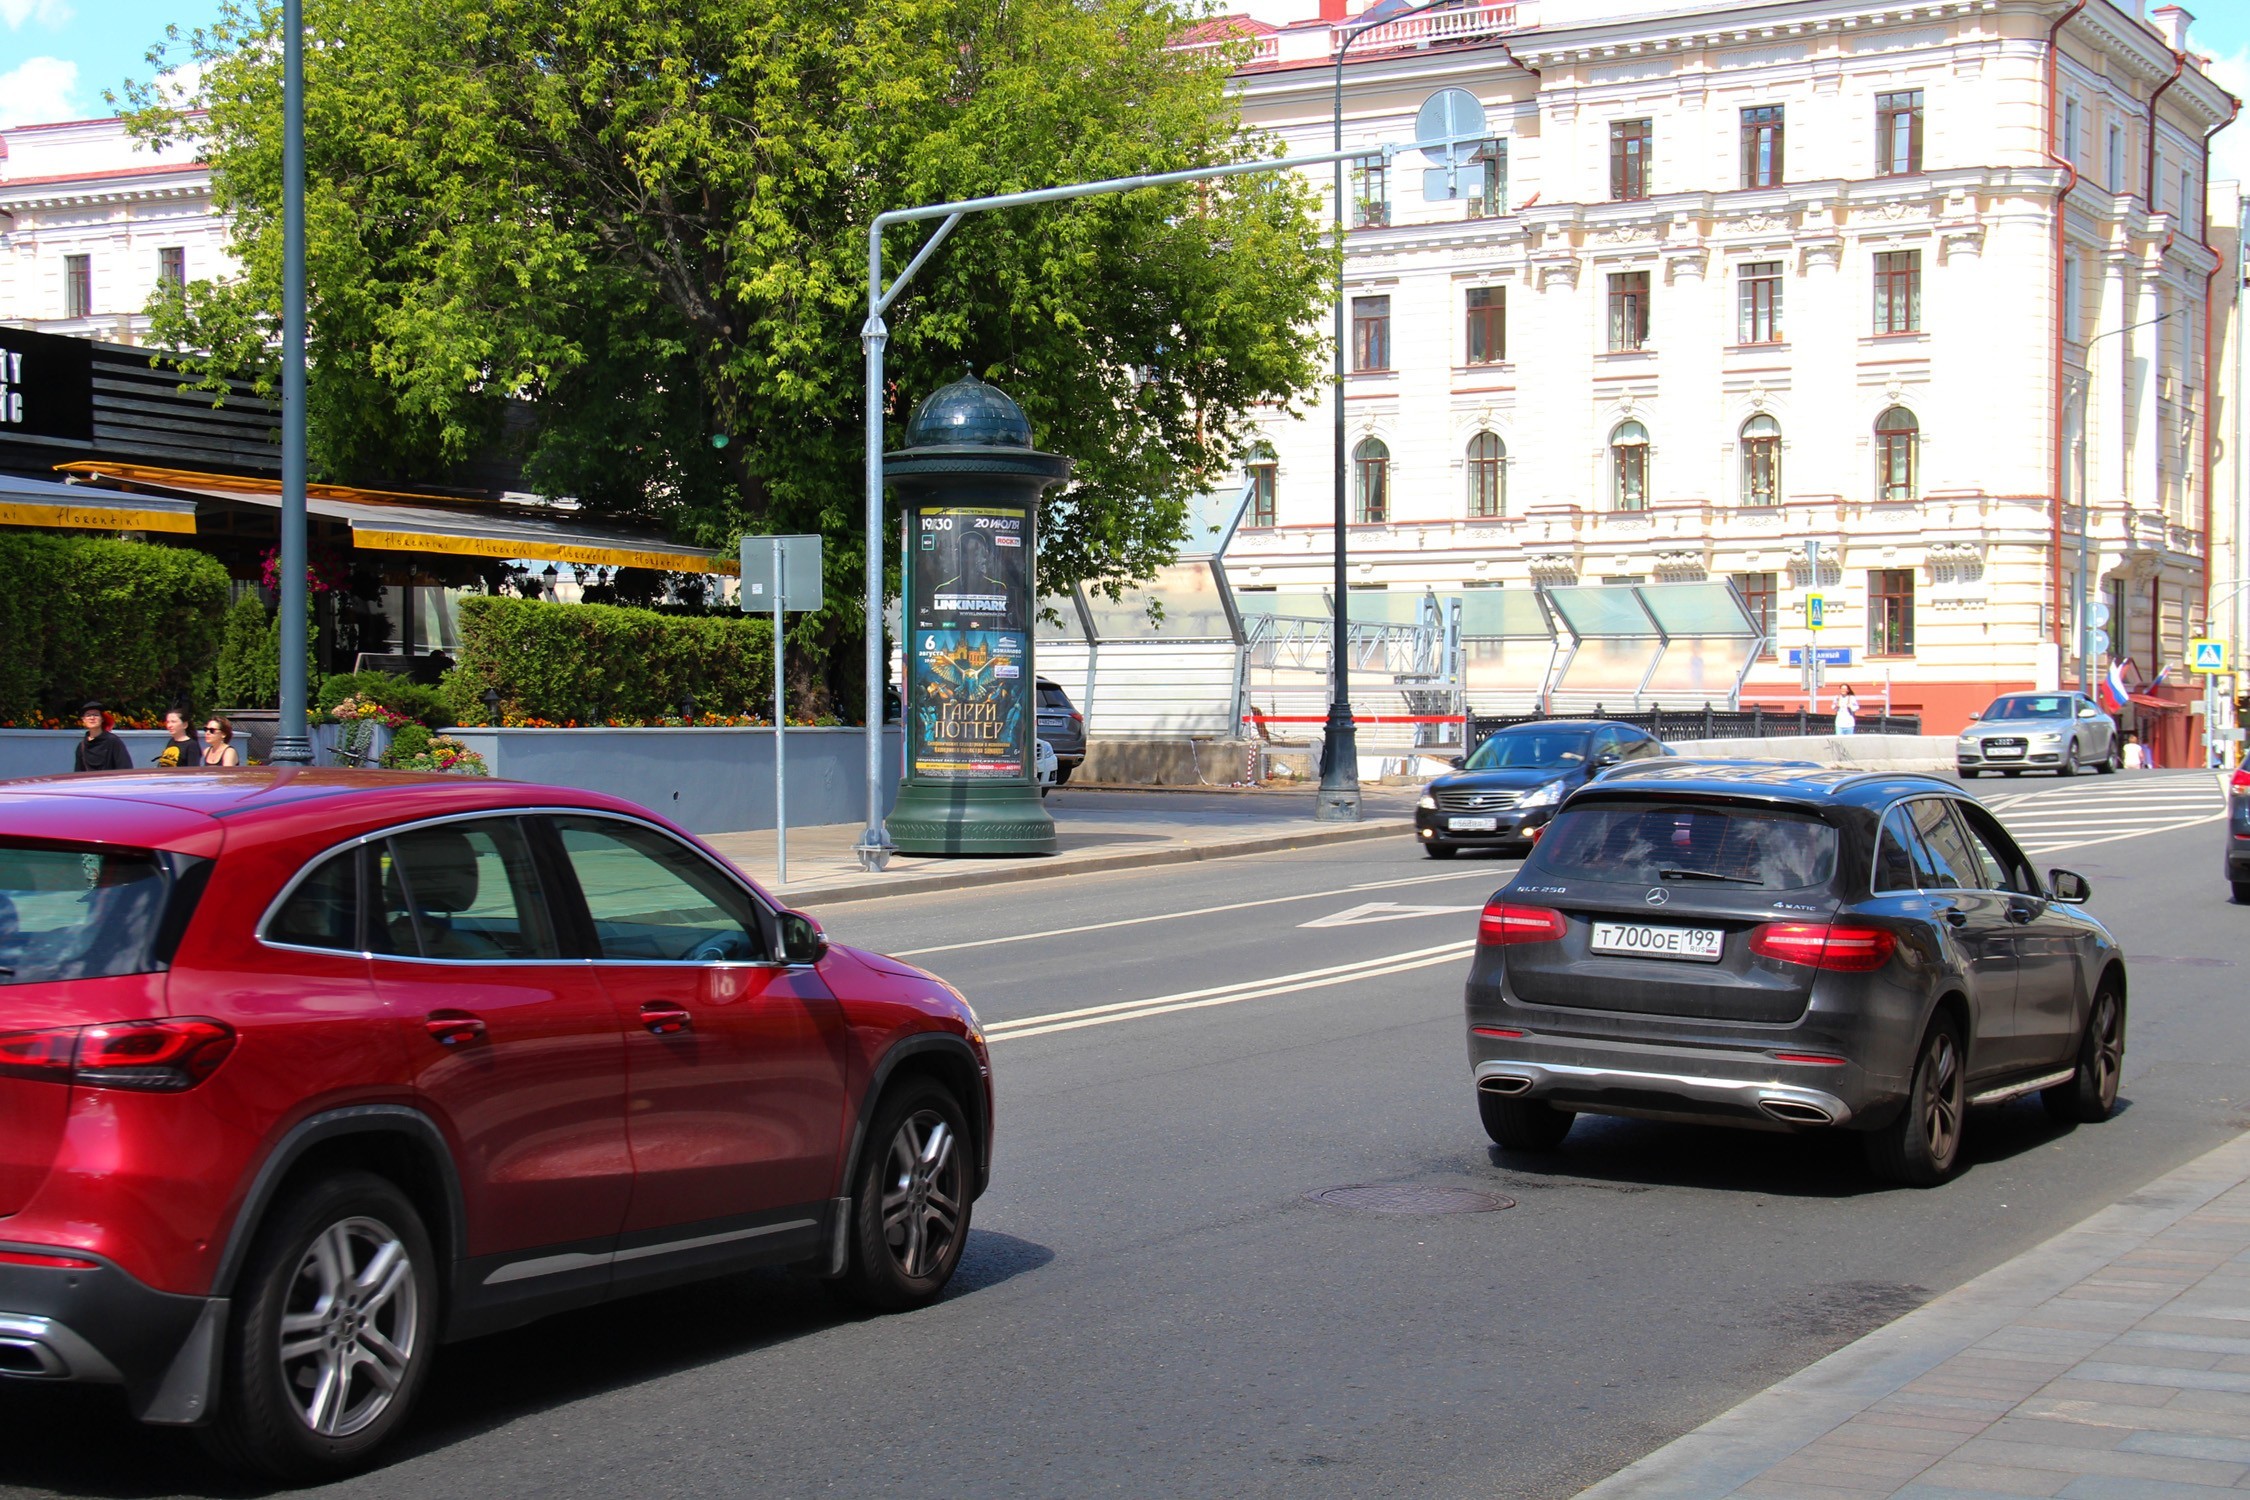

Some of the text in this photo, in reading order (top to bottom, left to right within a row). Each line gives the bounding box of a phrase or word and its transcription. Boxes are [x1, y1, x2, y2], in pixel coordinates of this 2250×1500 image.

[57, 505, 140, 526] florentini
[974, 518, 1020, 530] 20 ИЮЛЯ
[934, 599, 1008, 612] LINKIN PARK
[925, 635, 936, 650] 6
[942, 702, 997, 721] ГАРРИ
[934, 720, 1004, 739] ПОТТЕР
[1684, 929, 1715, 947] 199
[1690, 945, 1706, 953] RUS
